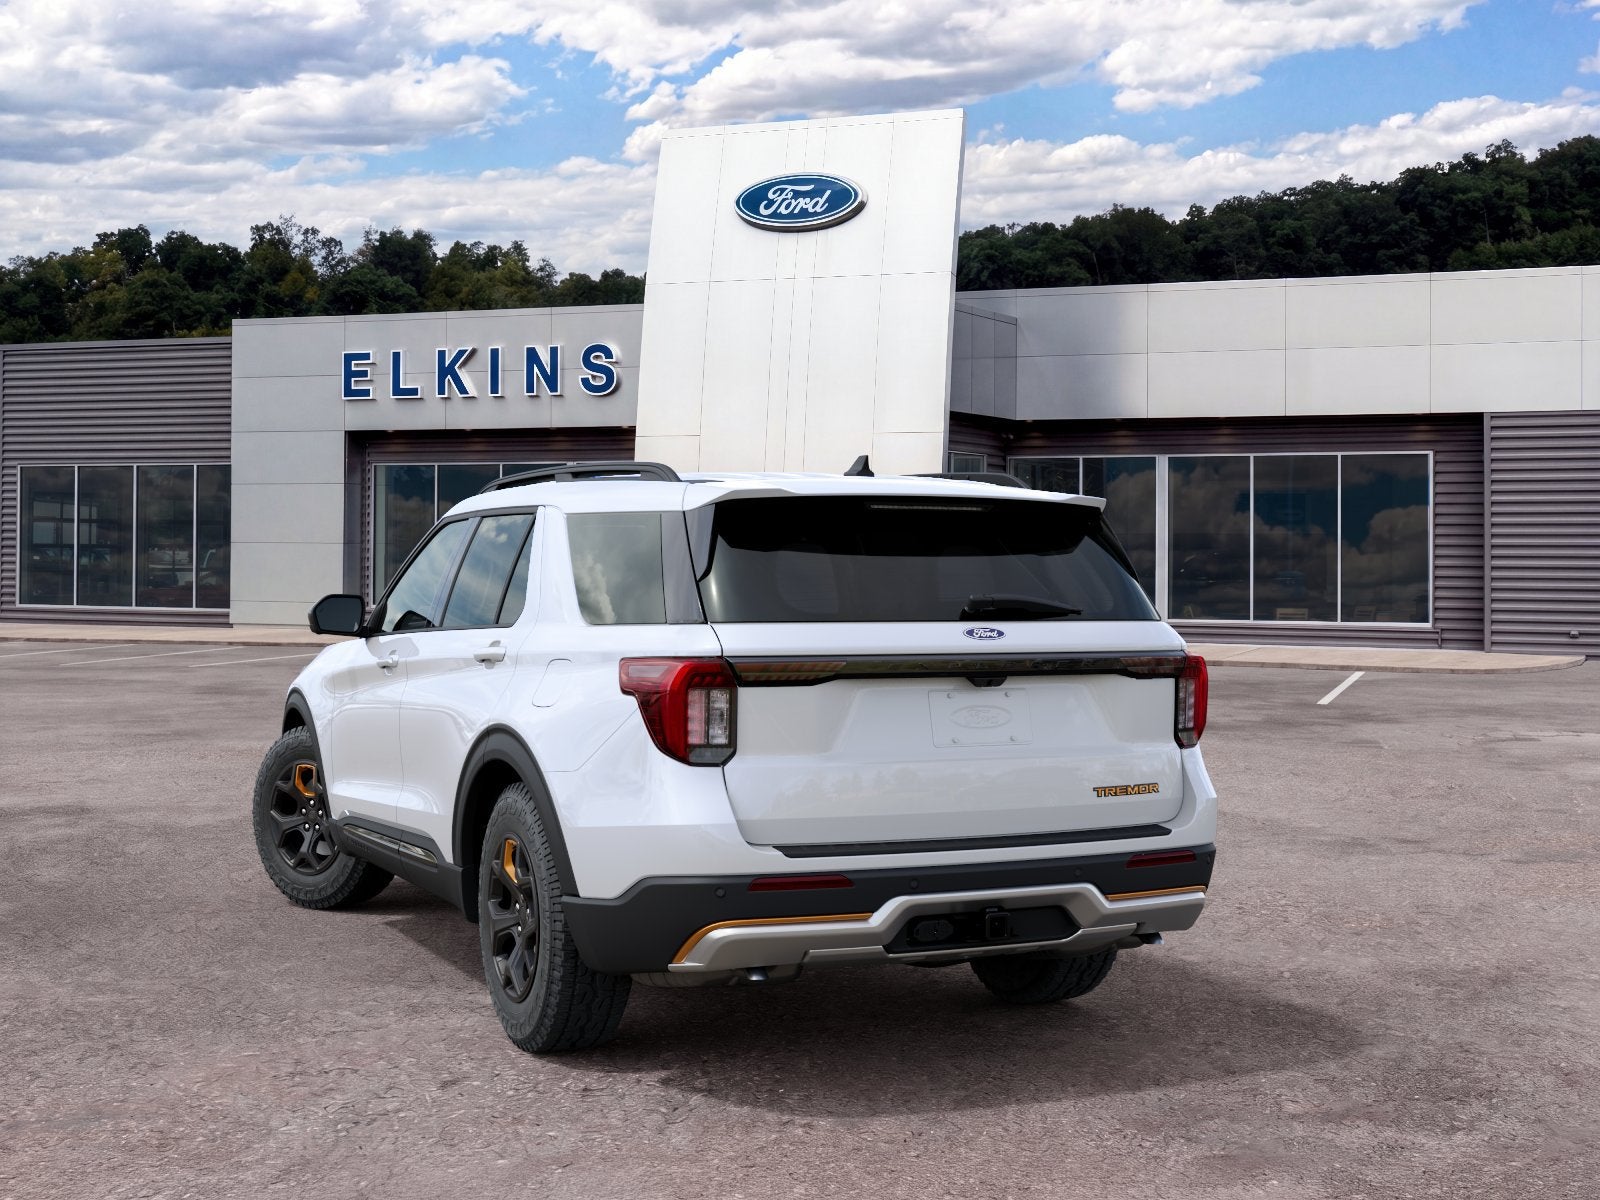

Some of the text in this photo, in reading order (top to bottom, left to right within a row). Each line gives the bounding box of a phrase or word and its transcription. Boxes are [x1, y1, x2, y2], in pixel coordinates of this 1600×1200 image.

[760, 184, 831, 215] Ford
[342, 342, 618, 399] ELKINS
[973, 628, 999, 638] Ford
[1093, 782, 1159, 797] TREMOR
